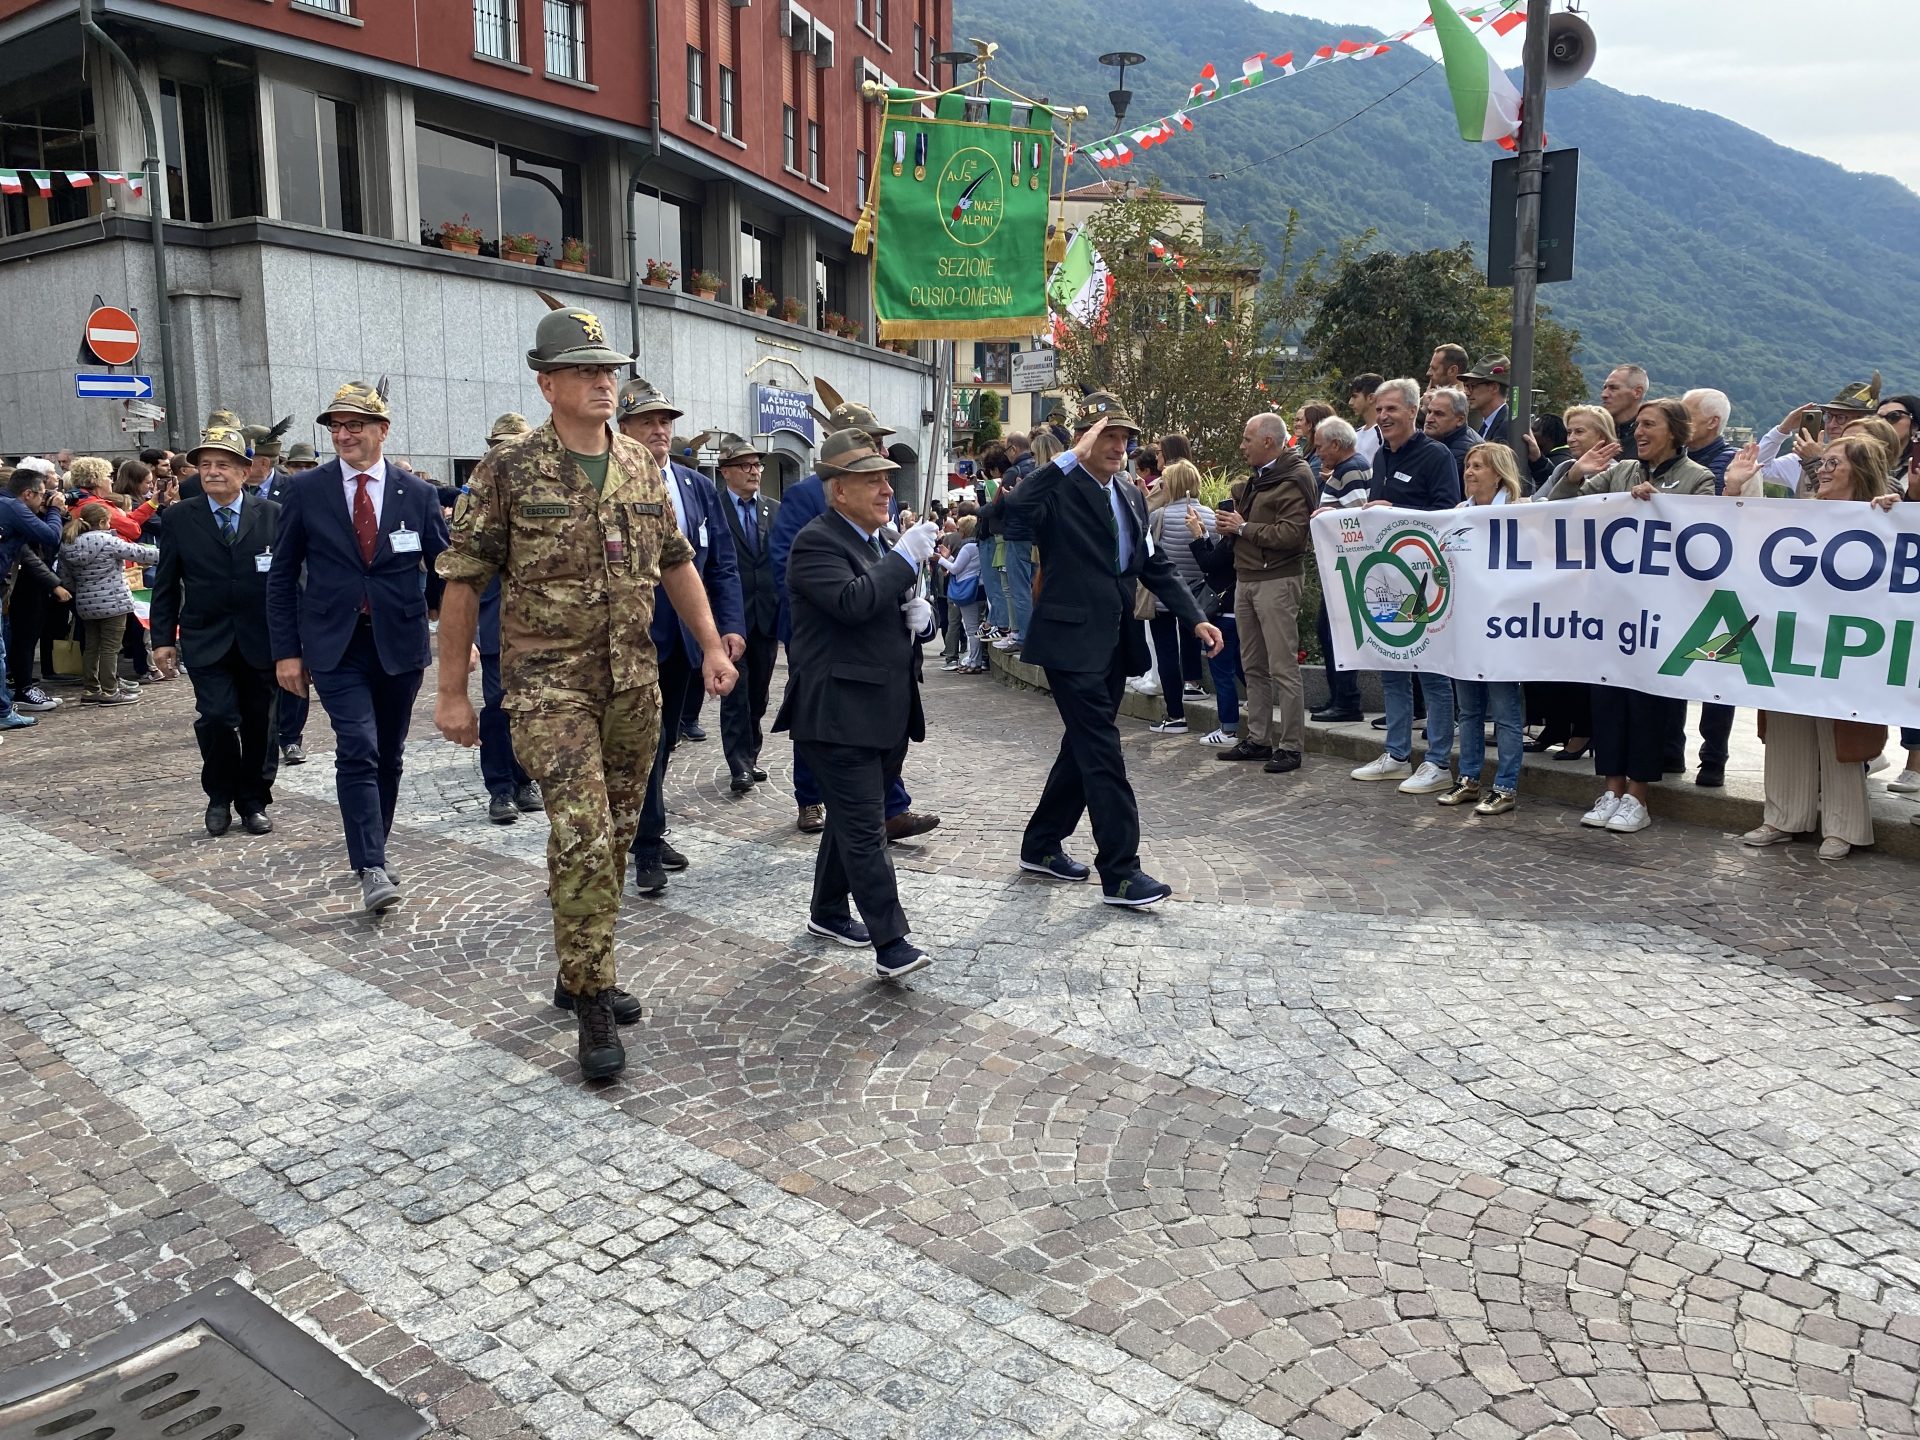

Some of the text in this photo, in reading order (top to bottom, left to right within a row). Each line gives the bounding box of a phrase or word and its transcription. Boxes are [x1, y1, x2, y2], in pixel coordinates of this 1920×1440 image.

[962, 215, 993, 226] ALPINI
[938, 257, 995, 277] SEZIONE
[910, 286, 1013, 306] CUSIO-OMEGNA
[768, 396, 807, 409] ALBERGO
[760, 403, 813, 420] BAR RISTORANTE
[526, 507, 566, 516] ESERCITO
[1339, 517, 1361, 530] 1924
[1341, 530, 1364, 543] 2024
[1375, 524, 1392, 545] SEZIONE
[1392, 519, 1410, 528] CUSIO
[1412, 520, 1440, 537] OMEGNA
[1336, 544, 1376, 553] 22 settembre
[1488, 516, 1920, 594] IL LICEO GOB
[1411, 558, 1432, 570] anni
[1486, 589, 1920, 688] saluta gli ALPI
[1366, 636, 1430, 660] pensando al futuro
